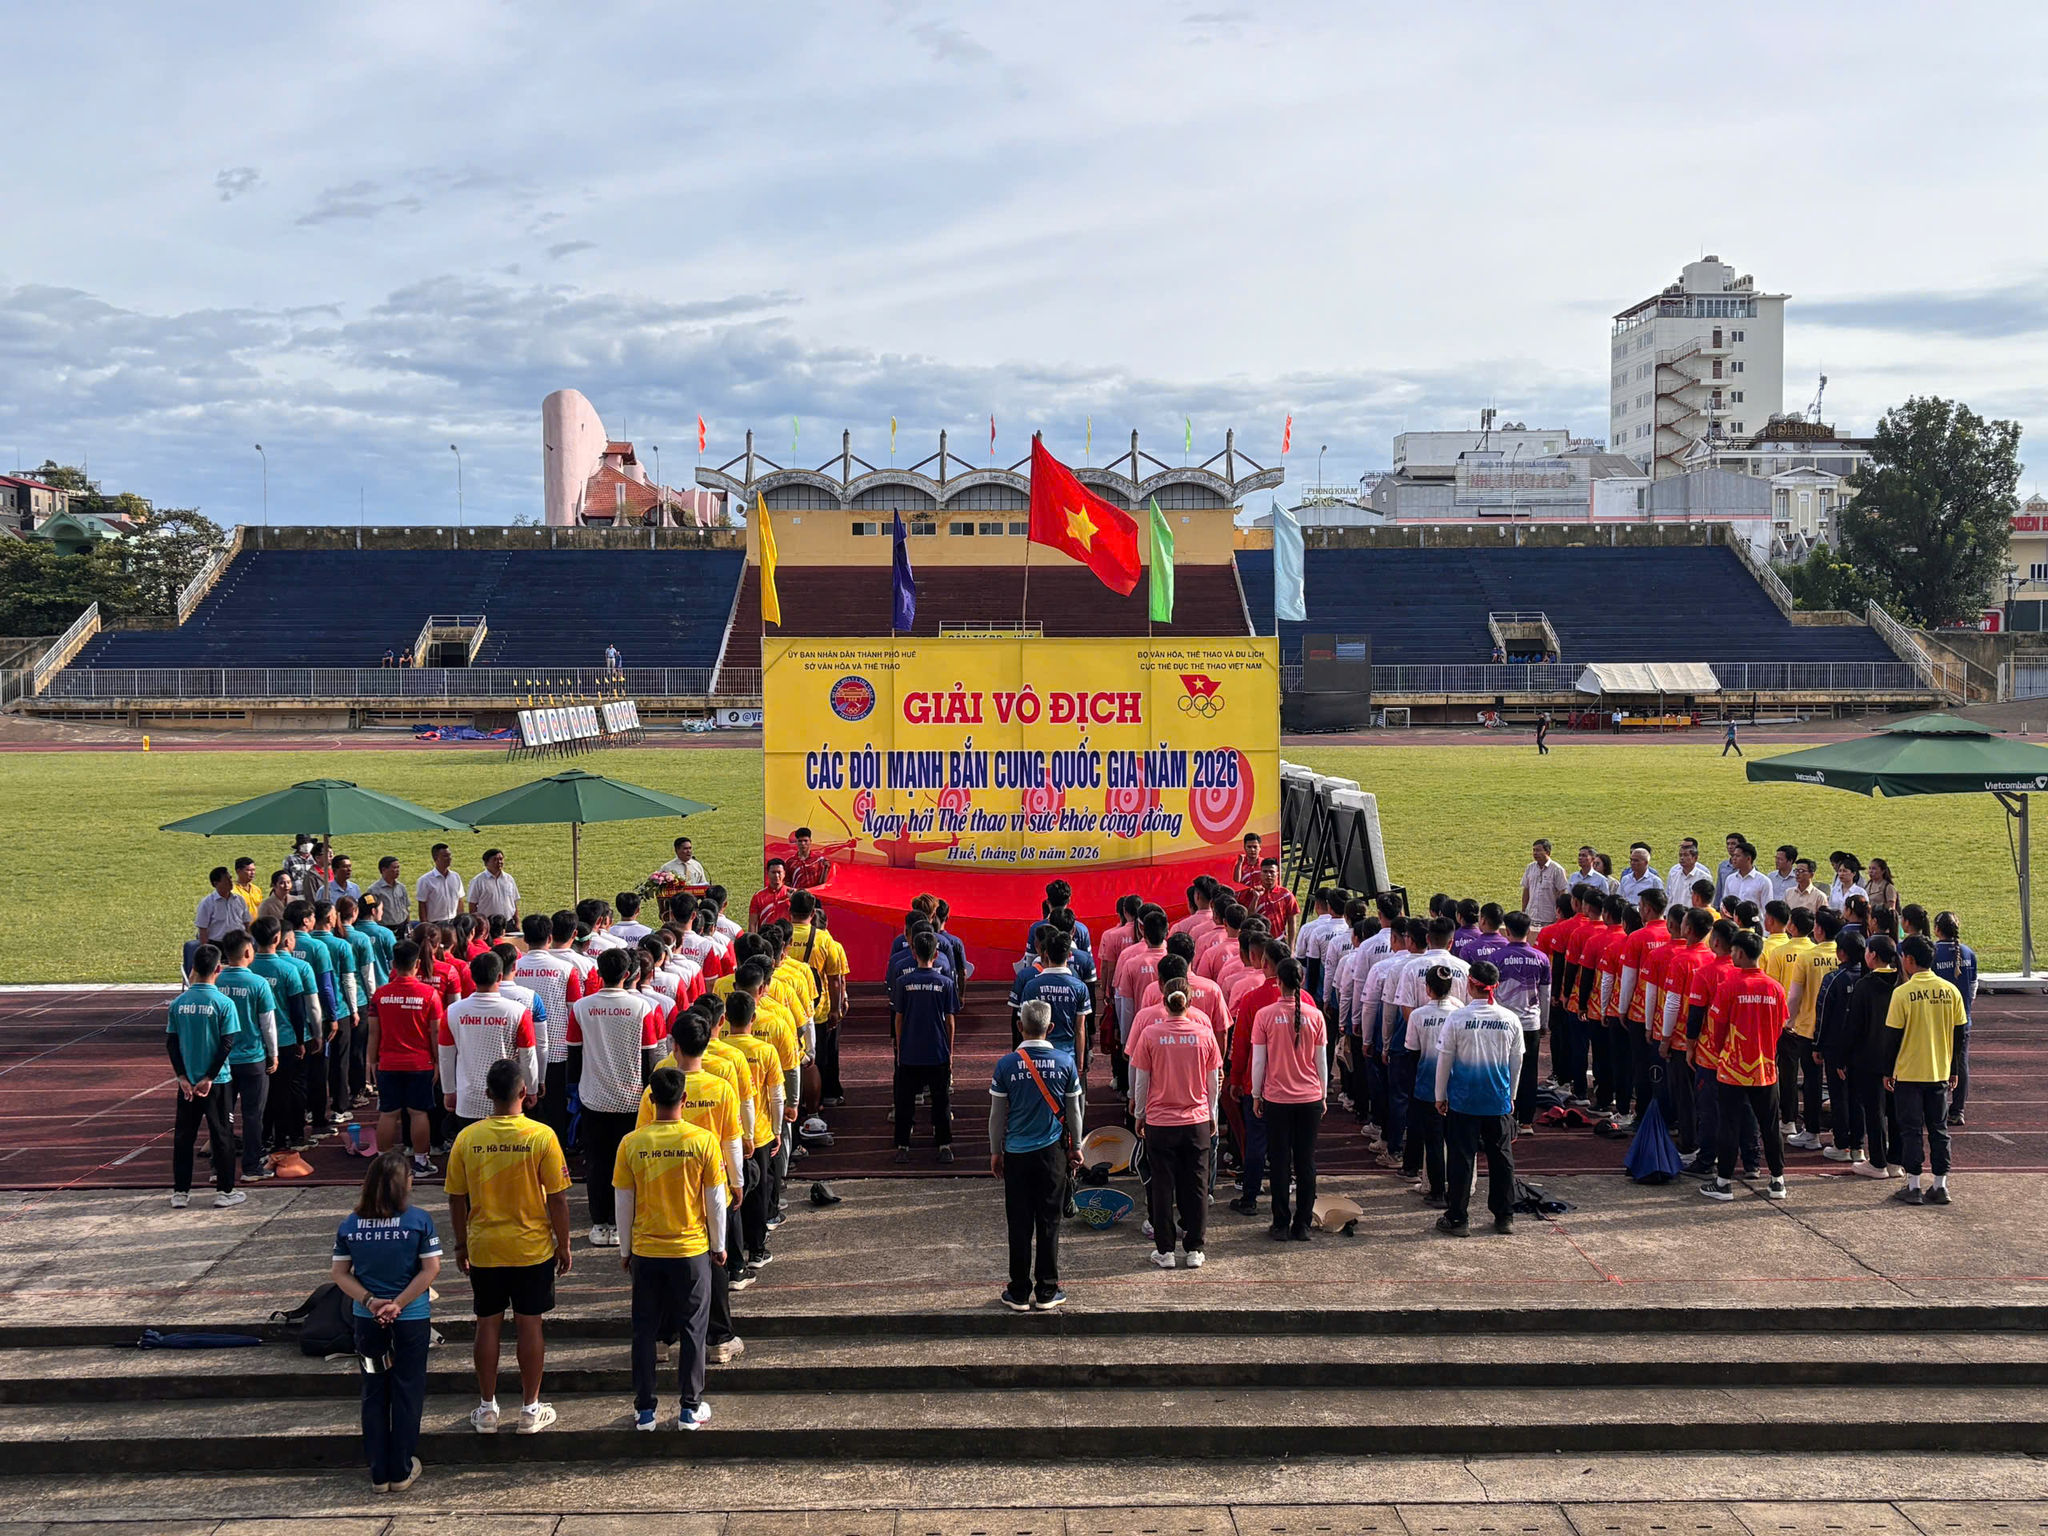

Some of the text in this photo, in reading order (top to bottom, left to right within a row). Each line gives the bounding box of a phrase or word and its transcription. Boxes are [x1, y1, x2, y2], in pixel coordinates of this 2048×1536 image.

[903, 682, 983, 724] GIẢI
[993, 684, 1041, 724] VÔ
[1049, 692, 1142, 732] ĐỊCH
[806, 736, 1239, 798] CÁC ĐỘI MẠNH BẮN CUNG QUỐC GIA NĂM 2026
[1984, 781, 2036, 790] Vietcombank
[862, 802, 1183, 839] Ngày hội Thể thao vì sức khỏe cộng đồng
[947, 844, 1100, 862] Huế, tháng 08 năm 2026
[535, 968, 559, 978] LONG
[1040, 985, 1070, 994] VIETNAM
[1737, 995, 1762, 1004] THANH
[1909, 990, 1929, 1002] DAK
[178, 1002, 196, 1014] PHÚ
[608, 1007, 632, 1017] LONG
[459, 1014, 508, 1026] VĨNH LONG
[1464, 1017, 1479, 1030] HẢI
[1160, 1034, 1176, 1045] HÀ
[1010, 1070, 1064, 1082] ARCERY
[698, 1100, 715, 1108] Minh
[500, 1144, 511, 1152] Chí
[512, 1144, 531, 1152] Minh
[663, 1149, 675, 1157] Chí
[676, 1148, 694, 1157] Minh
[357, 1217, 401, 1229] VIETNAM
[347, 1230, 410, 1241] ARCHERY
